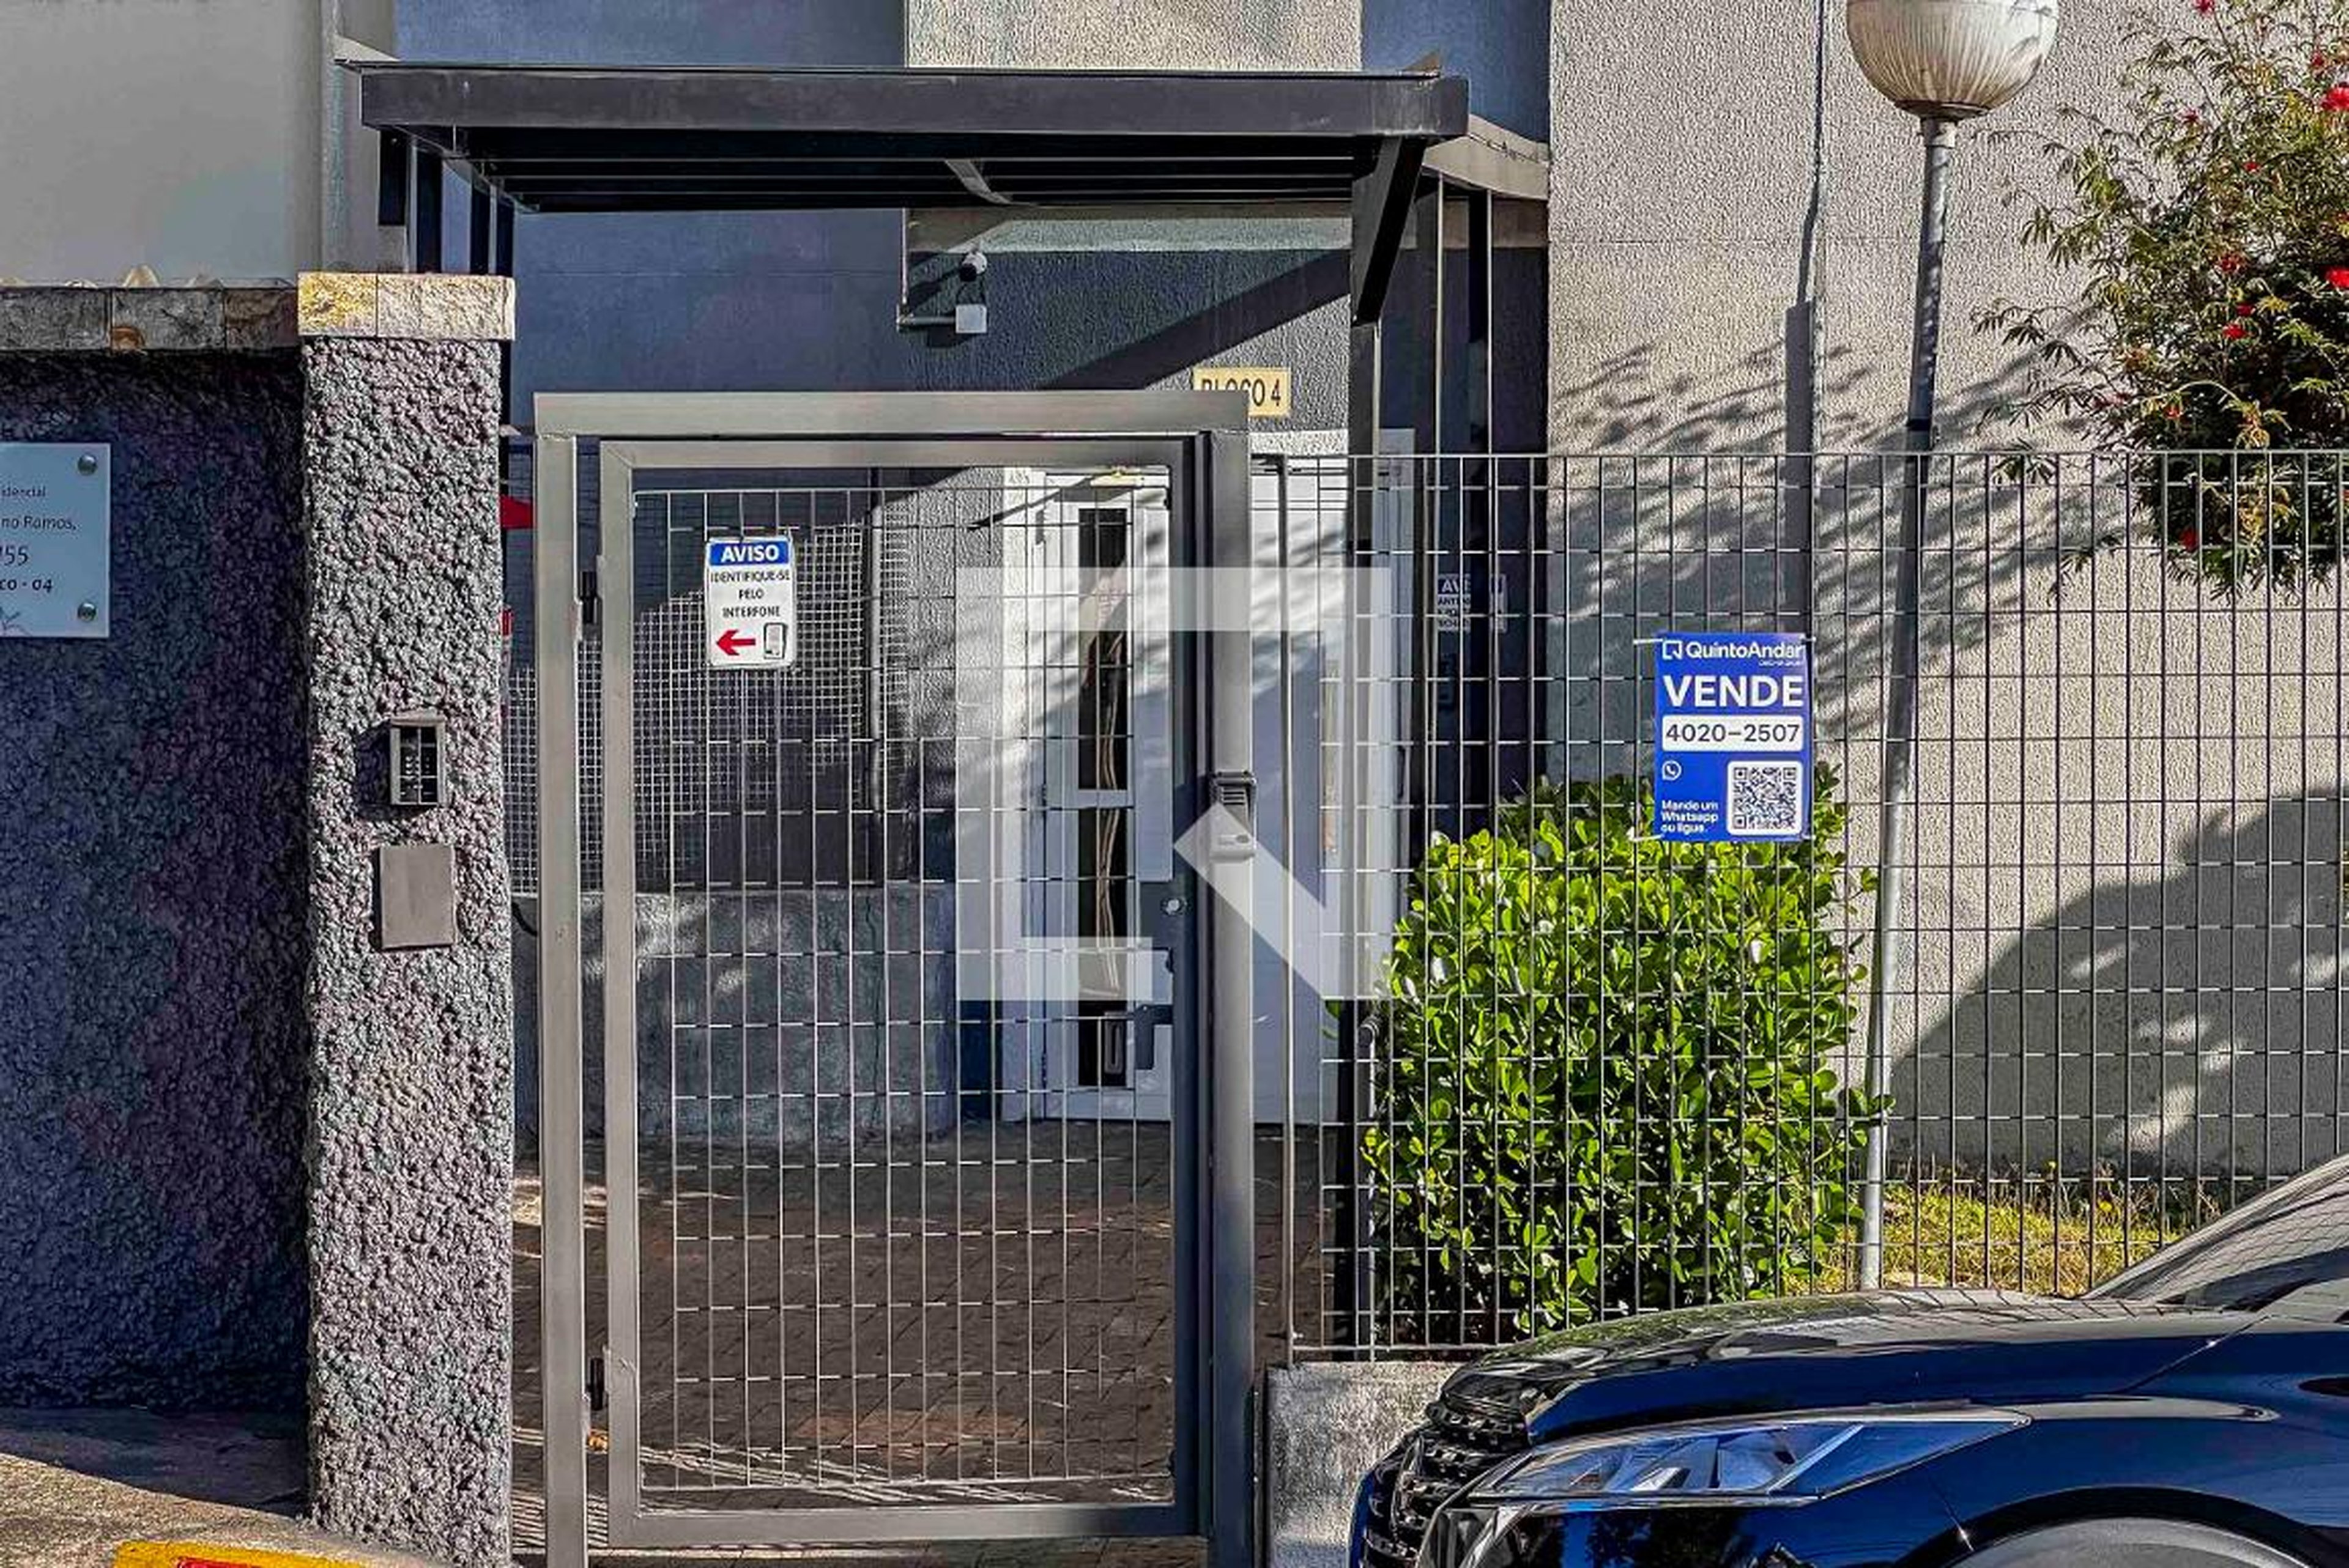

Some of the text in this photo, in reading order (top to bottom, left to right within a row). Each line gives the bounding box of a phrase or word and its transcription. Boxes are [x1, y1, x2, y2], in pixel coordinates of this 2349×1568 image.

[1271, 378, 1282, 407] 4
[24, 515, 76, 530] Ramos,
[721, 545, 780, 563] AVISO
[710, 569, 790, 583] IDENTIFIQUE-SE
[32, 579, 53, 594] 04
[738, 588, 765, 599] PELO
[722, 605, 781, 618] INTERFONE
[1686, 641, 1802, 659] QuintoAndar
[1663, 675, 1804, 708] VENDE
[1666, 723, 1800, 742] 4020-2507
[1661, 799, 1719, 811] Mande um
[1660, 824, 1675, 832] ou
